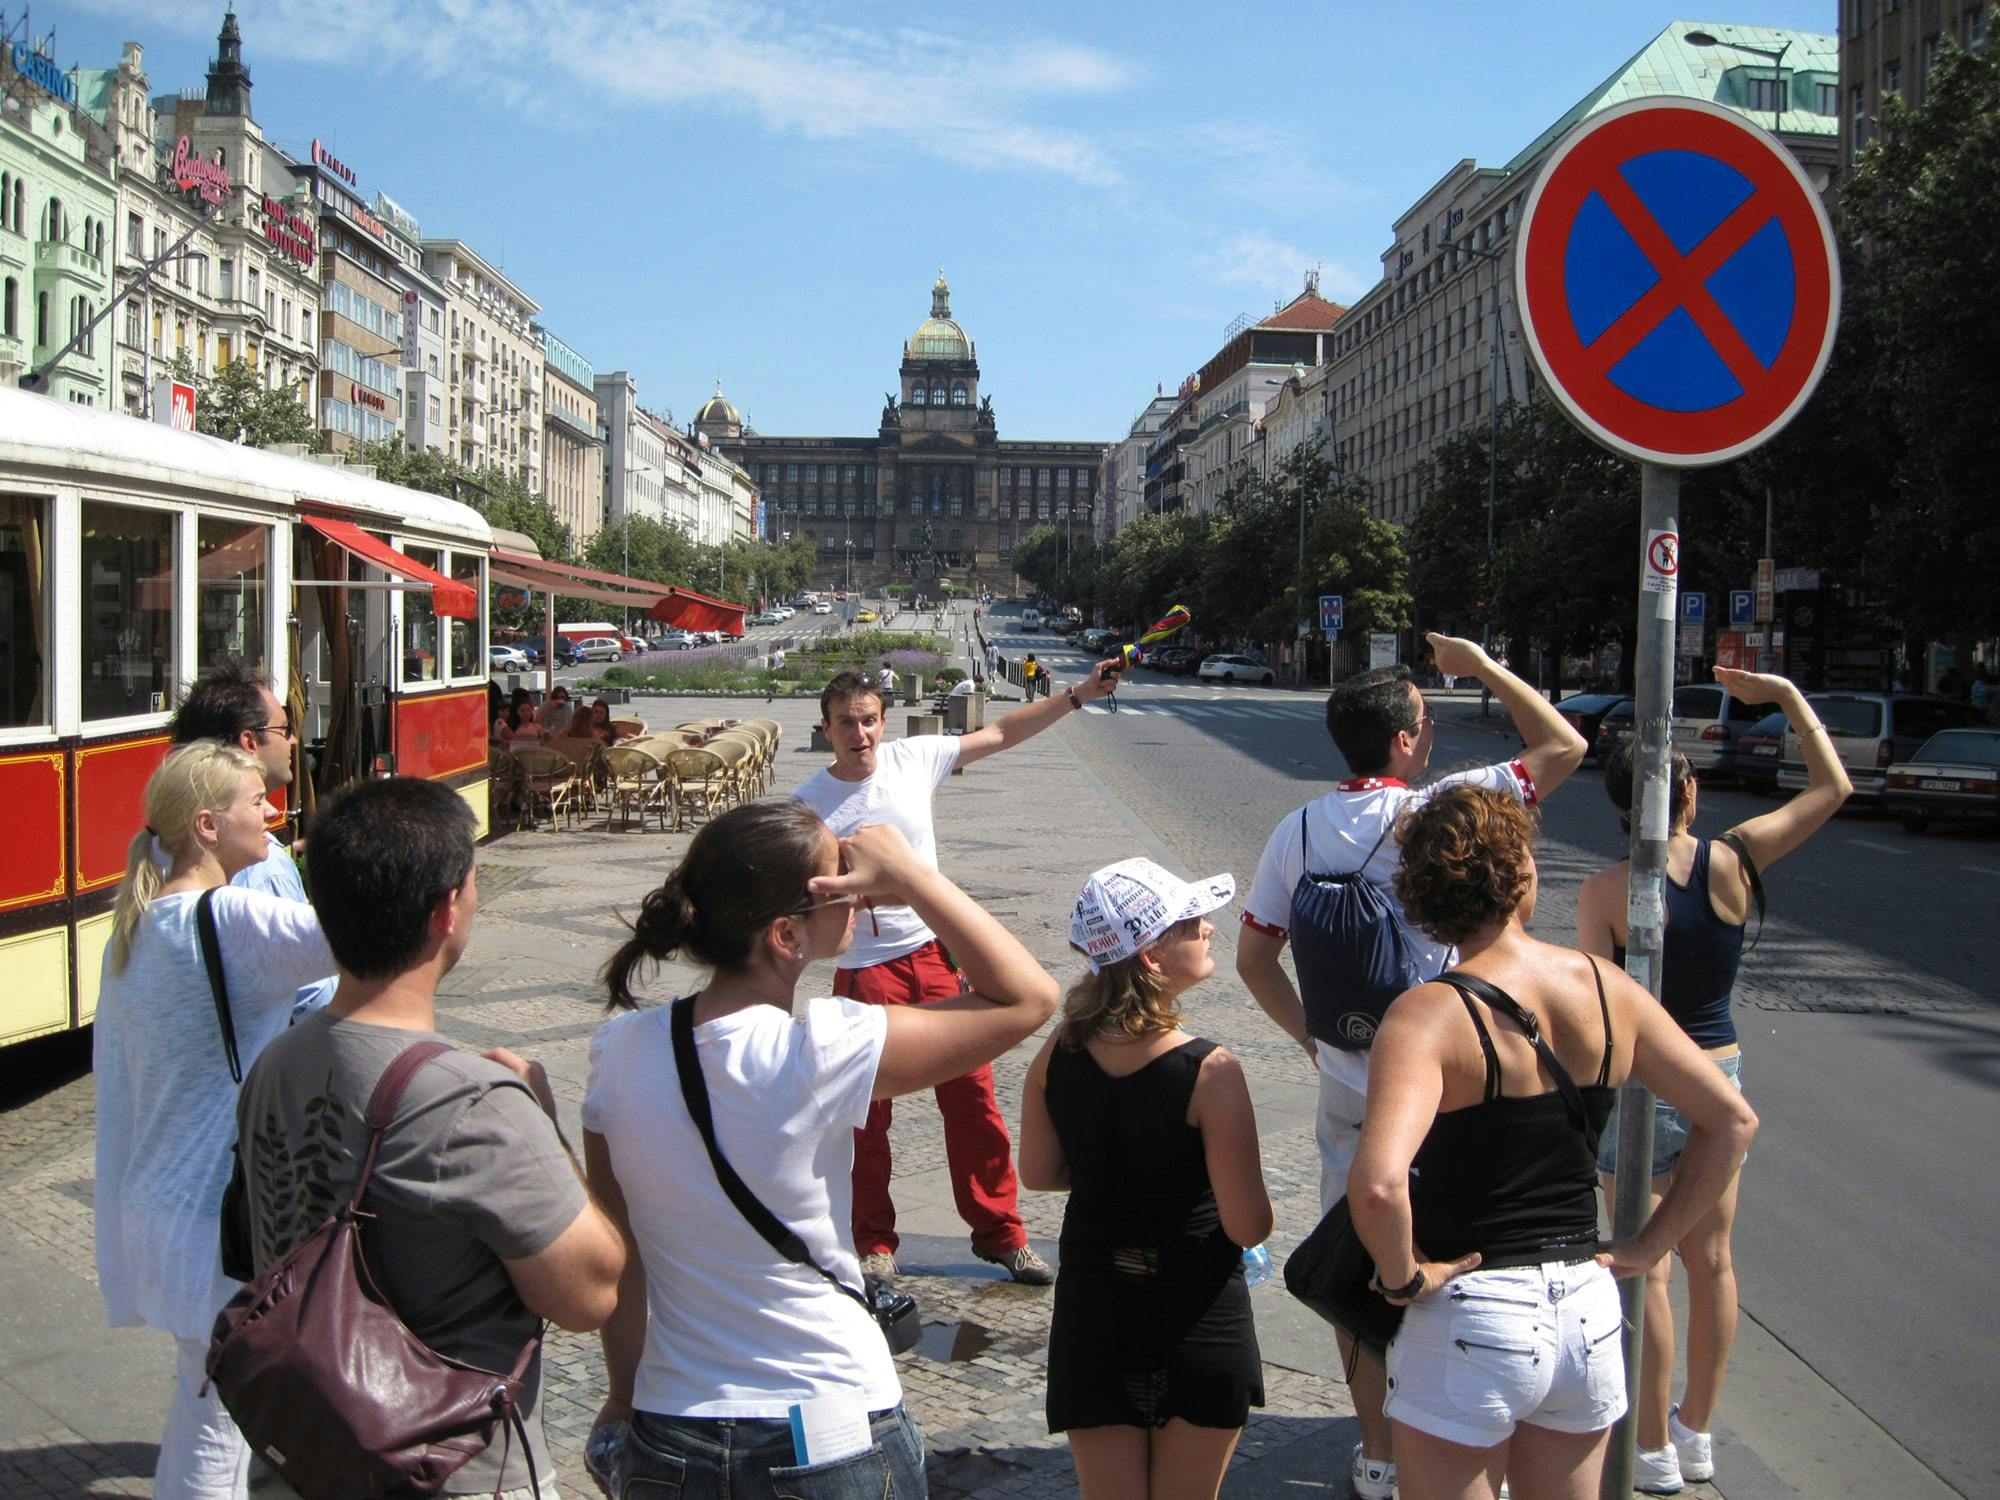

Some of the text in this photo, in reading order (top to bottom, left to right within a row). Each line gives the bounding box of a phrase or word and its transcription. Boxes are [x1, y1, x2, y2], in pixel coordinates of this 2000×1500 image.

[12, 41, 73, 102] CASINO
[321, 148, 357, 187] RAMADA
[406, 309, 415, 367] RAMADA
[1686, 596, 1699, 614] P
[1735, 595, 1749, 614] P
